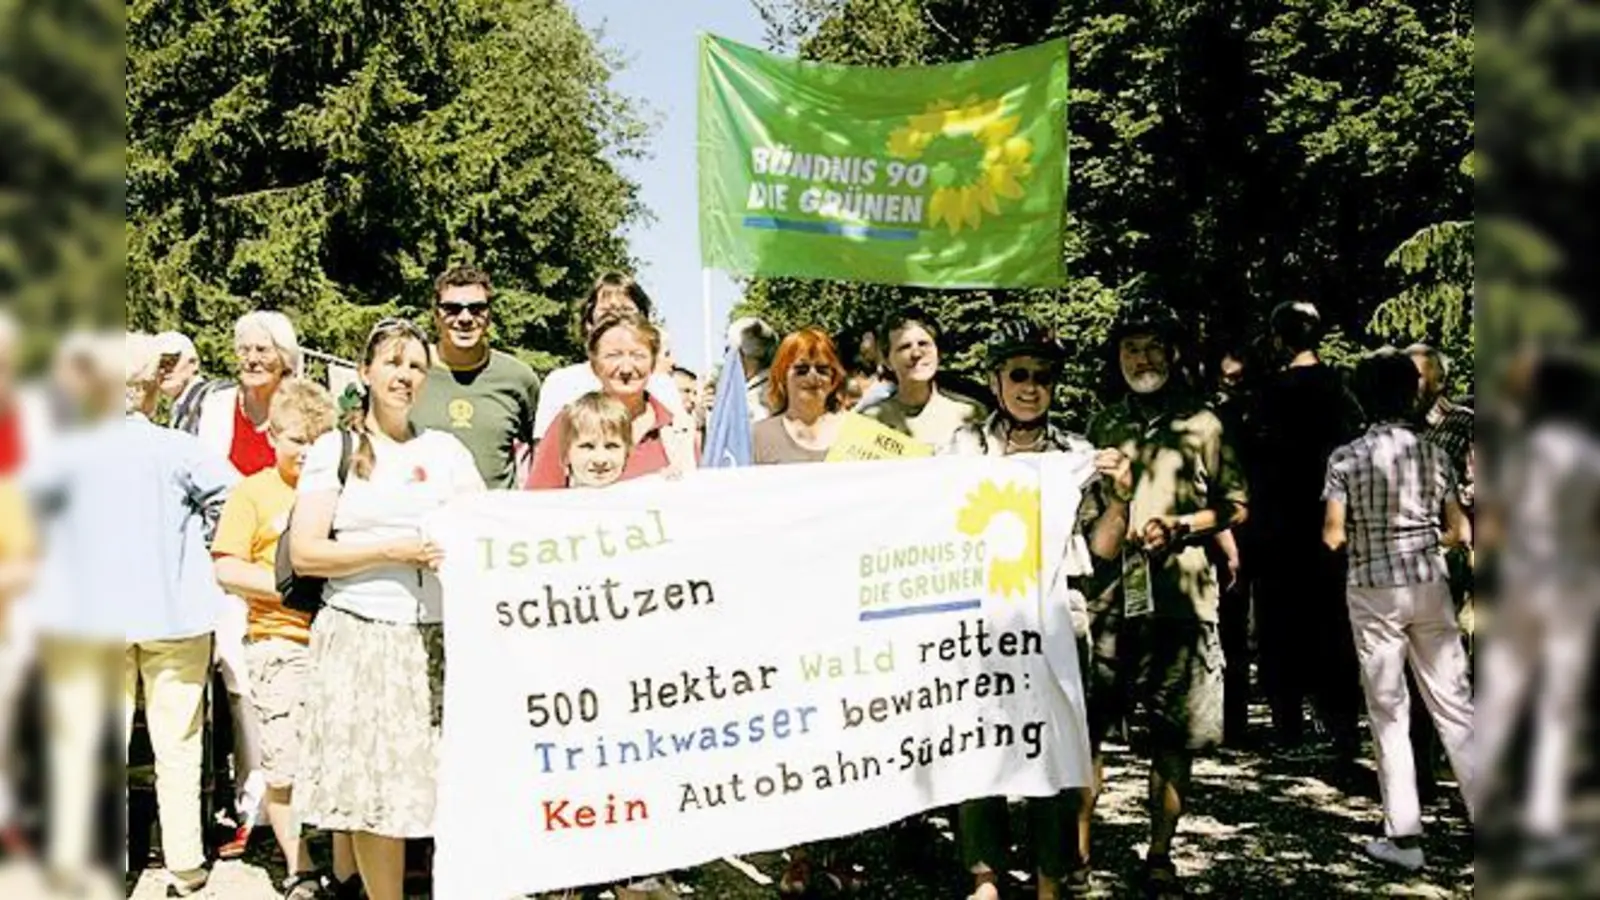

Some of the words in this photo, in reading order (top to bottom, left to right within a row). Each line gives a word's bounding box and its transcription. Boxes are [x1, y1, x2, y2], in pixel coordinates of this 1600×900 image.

[752, 143, 876, 185] BÜNDNIS
[886, 161, 928, 187] 90
[747, 182, 787, 211] DIE
[800, 186, 924, 223] GRÜNEN
[875, 433, 904, 456] KEIN
[477, 508, 673, 571] Isartal
[859, 541, 955, 579] BÜNDNIS
[961, 539, 986, 563] 90
[496, 577, 715, 628] schützen
[859, 580, 891, 606] DIE
[899, 565, 983, 600] GRÜNEN
[527, 687, 599, 728] 500
[629, 665, 779, 714] Hektar
[799, 640, 896, 681] Wald
[918, 618, 1044, 664] retten
[534, 703, 818, 773] Trinkwasser
[840, 670, 1031, 730] bewahren:
[541, 794, 650, 832] Kein
[678, 716, 1046, 812] Autobahn-Südring
